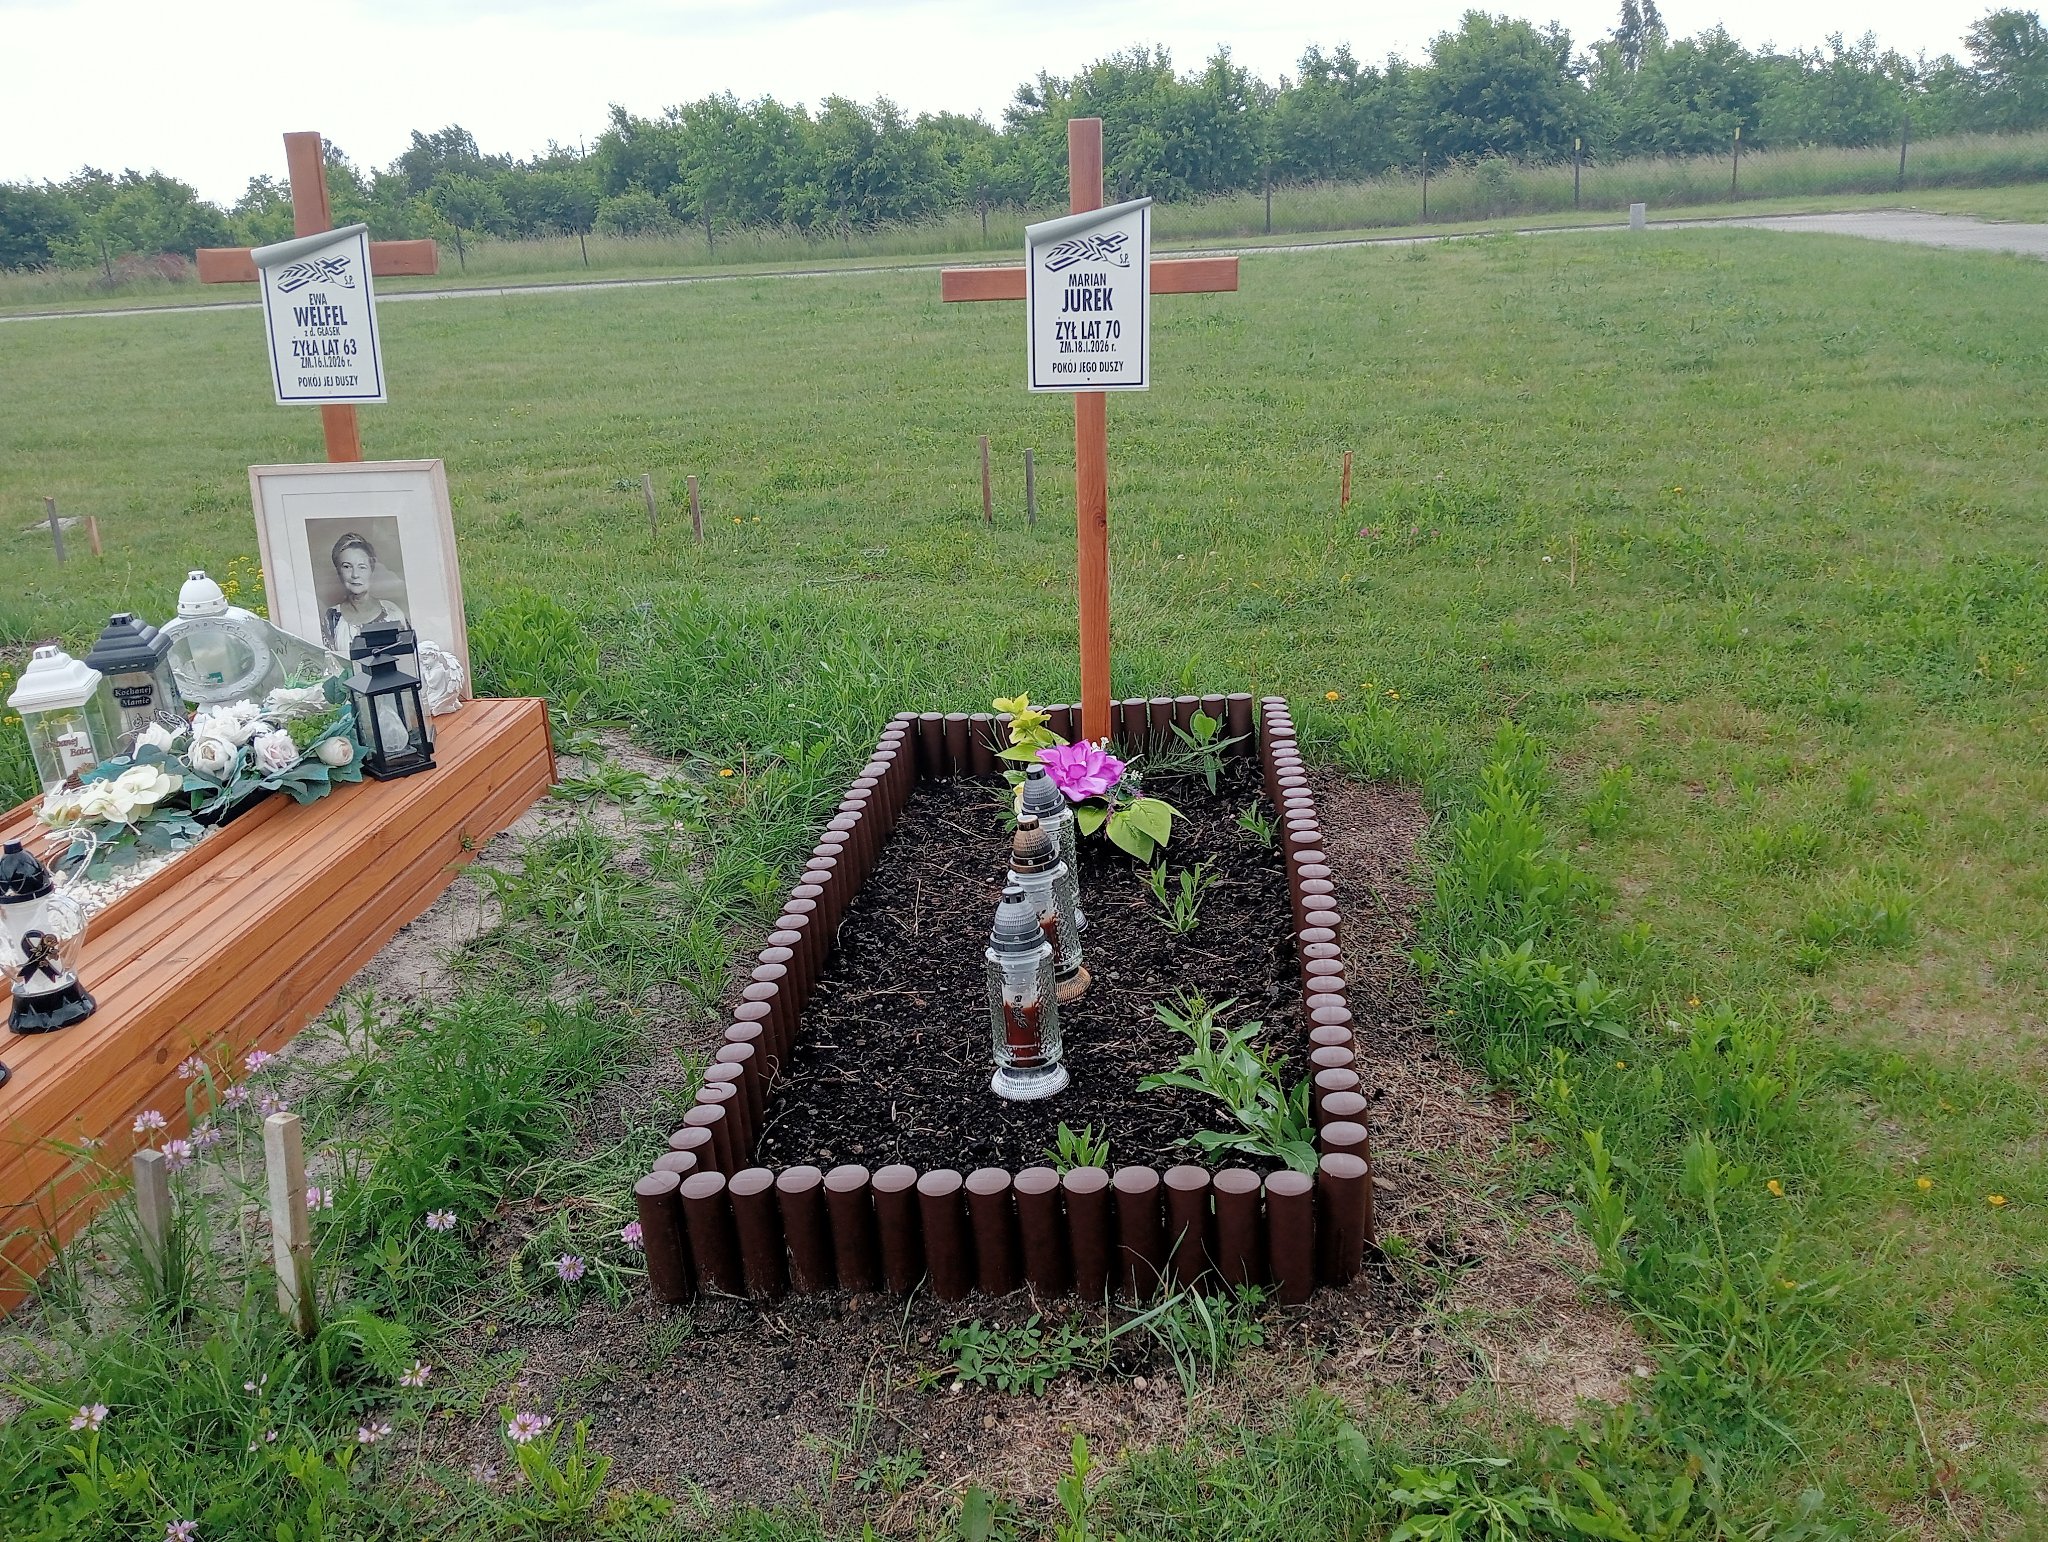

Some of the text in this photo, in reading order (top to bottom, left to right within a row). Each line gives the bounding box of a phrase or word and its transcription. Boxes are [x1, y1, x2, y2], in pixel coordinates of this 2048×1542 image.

[1068, 273, 1107, 287] MARIAN
[309, 293, 328, 306] EWA
[1061, 288, 1114, 313] JUREK
[293, 305, 348, 327] WELFEL
[1055, 316, 1121, 340] ŻYŁ LAT 70
[292, 336, 357, 357] ŻYŁA LAT 63
[1052, 359, 1124, 374] POKÓJ JEGO DUSZY
[298, 373, 358, 388] POKÓJ JEJ DUSZY
